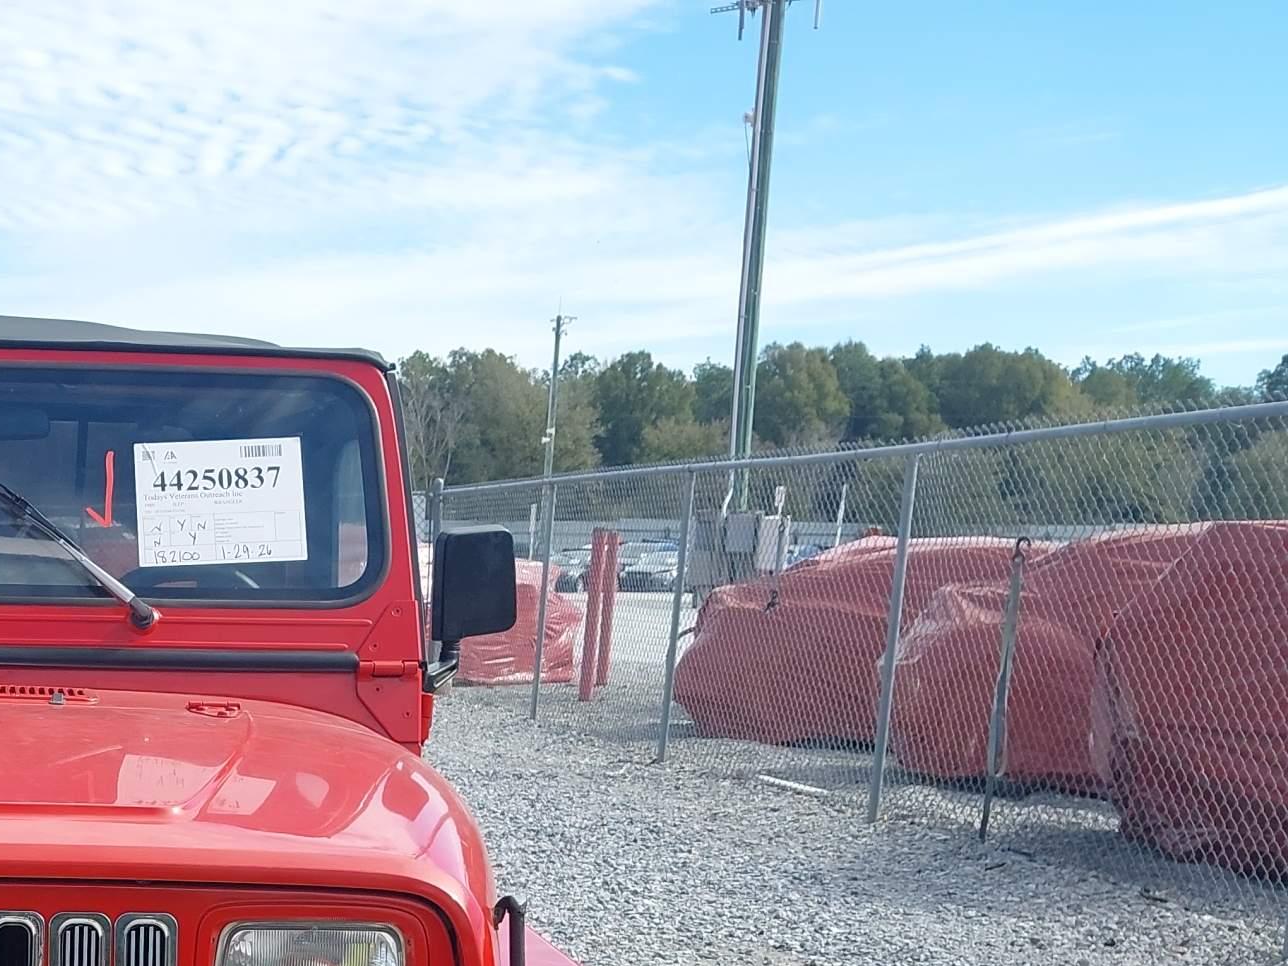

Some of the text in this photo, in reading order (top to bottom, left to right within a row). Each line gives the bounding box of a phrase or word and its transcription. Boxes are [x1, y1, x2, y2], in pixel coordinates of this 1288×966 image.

[153, 466, 281, 491] 44250837
[144, 494, 167, 503] Todays
[169, 492, 198, 500] Veterans
[177, 519, 186, 531] Y
[188, 531, 198, 546] Y
[154, 550, 201, 564] 182100
